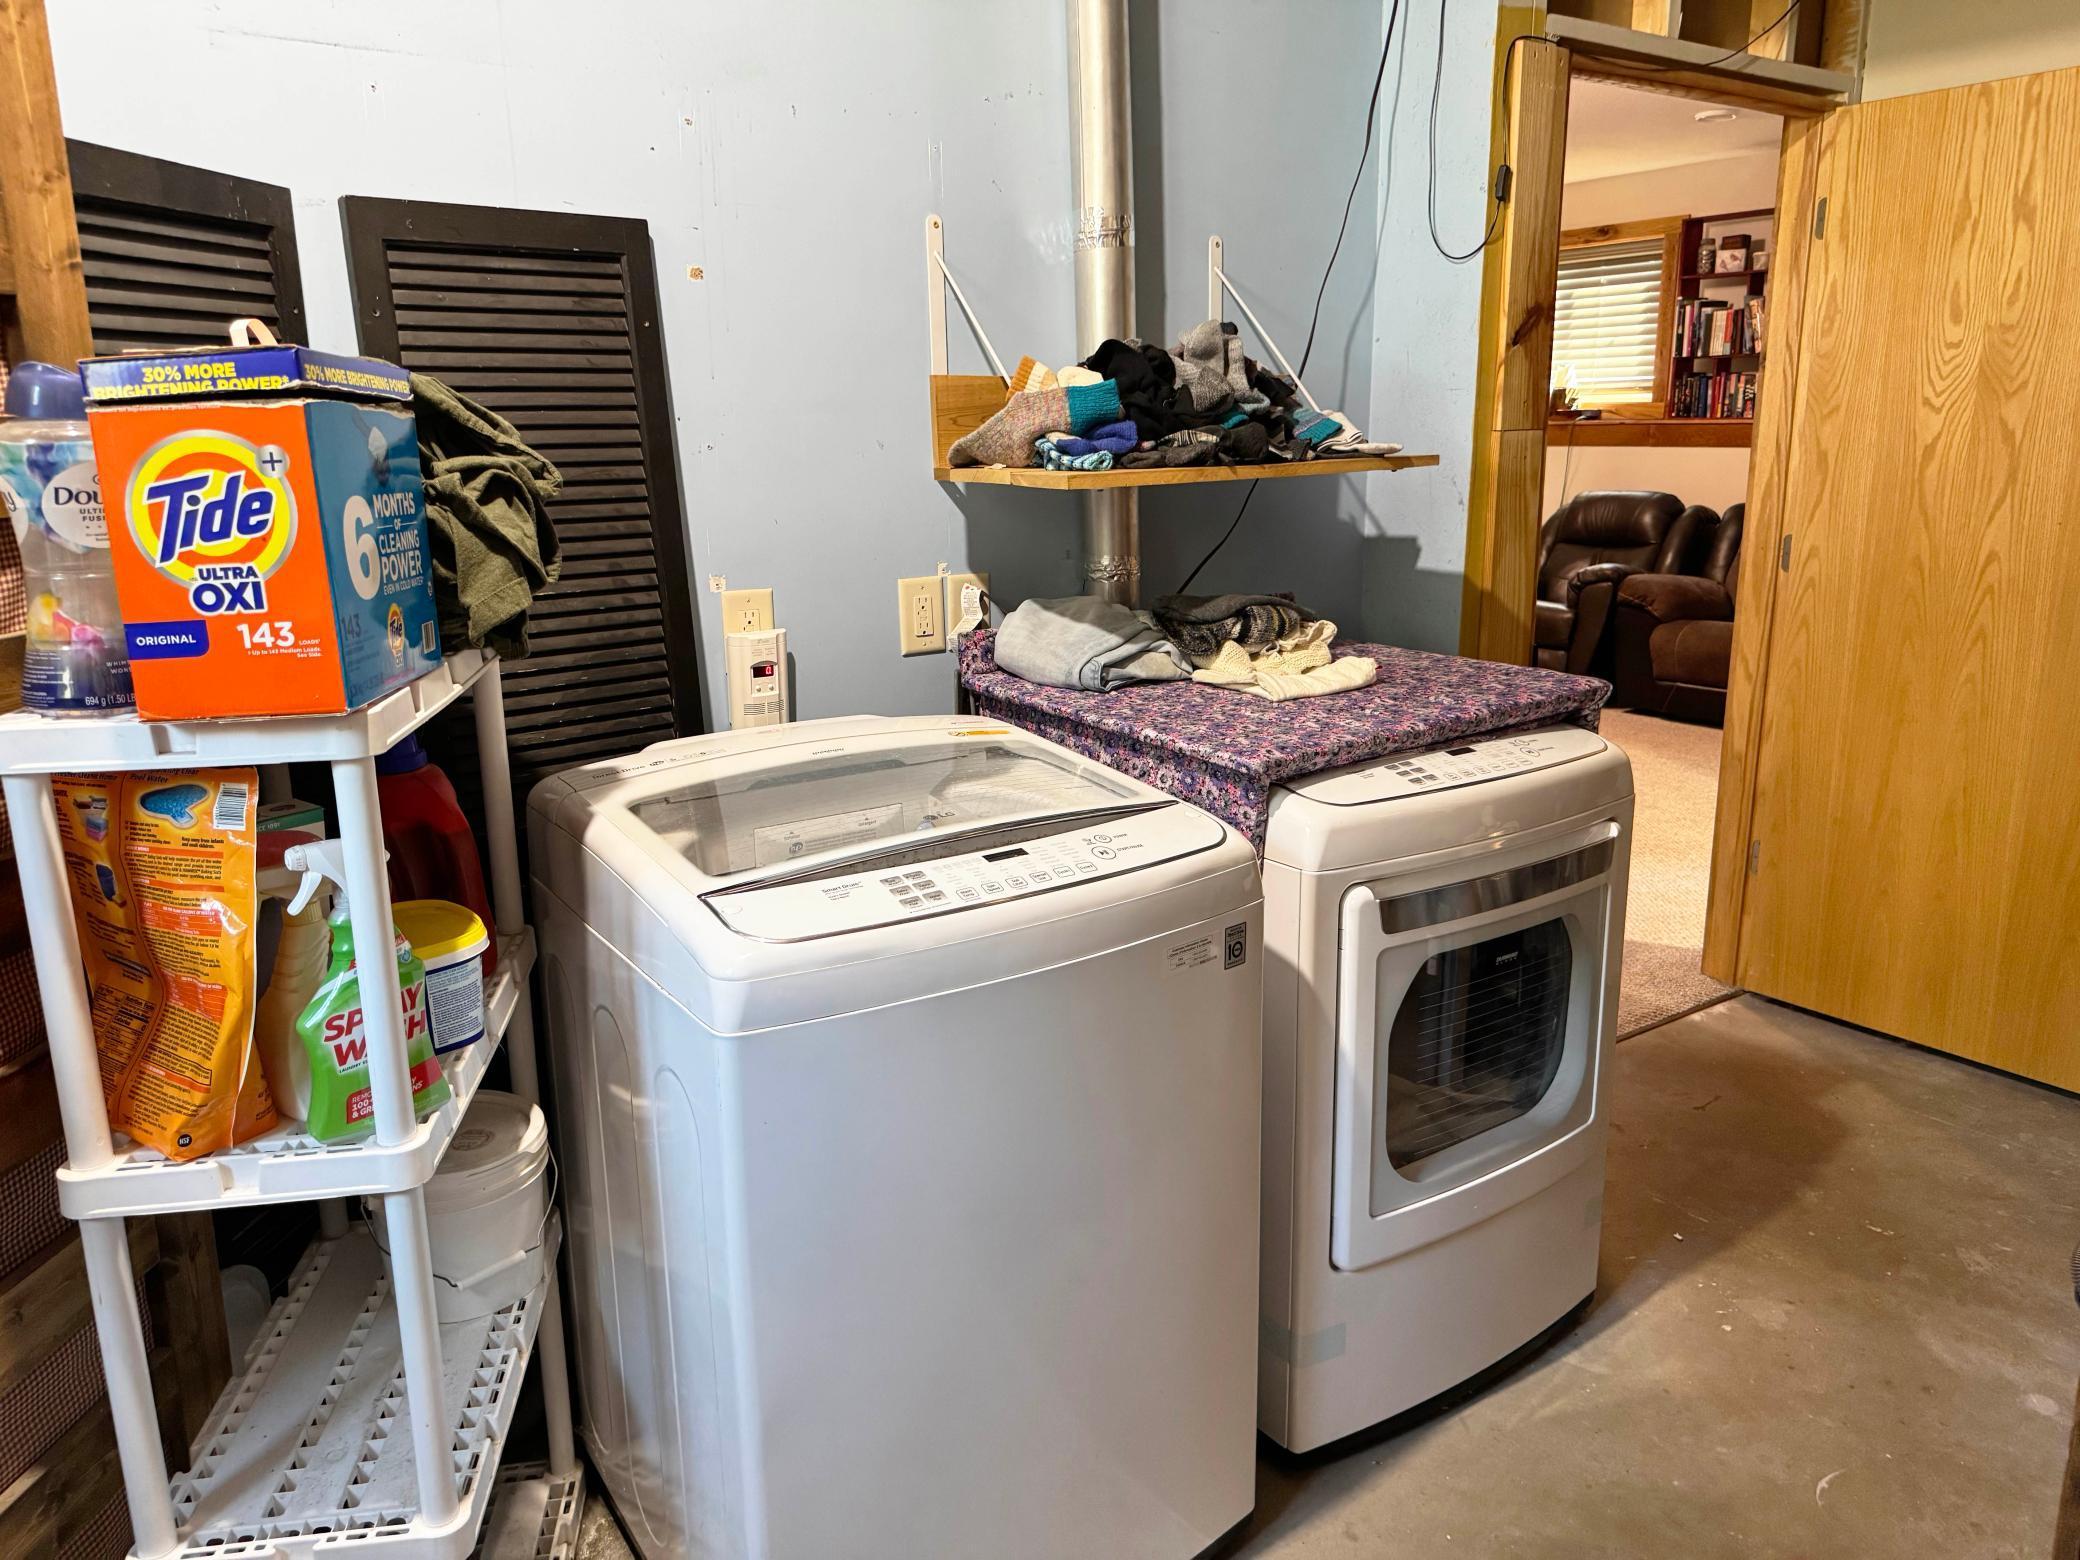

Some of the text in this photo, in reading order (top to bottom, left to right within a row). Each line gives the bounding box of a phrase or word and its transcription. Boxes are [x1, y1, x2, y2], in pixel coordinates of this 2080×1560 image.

[142, 362, 236, 383] 30% MORE
[303, 363, 324, 381] 30%
[324, 367, 347, 384] MORE
[346, 370, 389, 390] BRIGHTENING
[92, 380, 214, 400] BRIGHTENING
[144, 472, 275, 566] Tide
[393, 518, 402, 530] OF
[343, 495, 381, 600] 6
[372, 491, 416, 518] MONTHS
[378, 529, 420, 554] CLEANING
[198, 566, 259, 581] ULTRA
[381, 550, 423, 583] POWER
[192, 580, 265, 613] OXI
[136, 634, 196, 647] ORIGINAL
[236, 621, 296, 649] 143
[85, 696, 99, 706] 694
[100, 697, 107, 707] g
[352, 1091, 372, 1103] REMO
[179, 1136, 191, 1145] NSF
